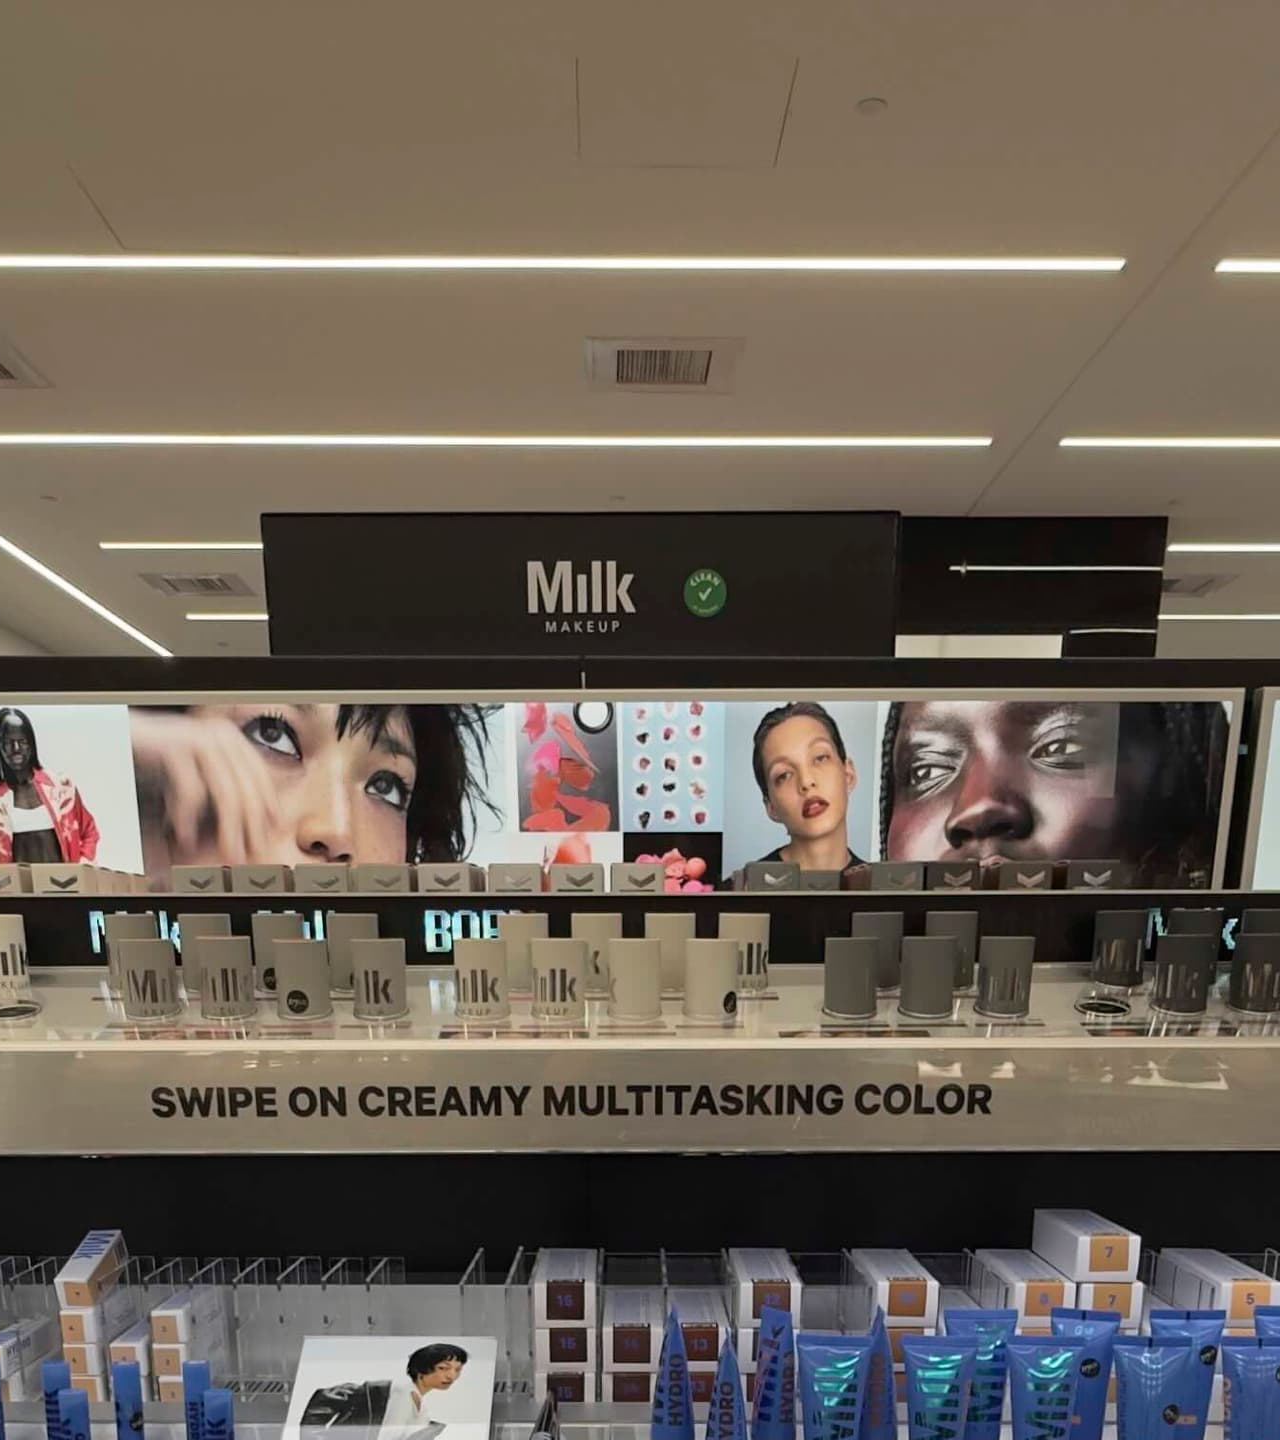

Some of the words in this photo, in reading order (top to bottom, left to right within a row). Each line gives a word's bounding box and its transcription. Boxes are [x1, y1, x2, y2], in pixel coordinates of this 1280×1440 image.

[526, 560, 636, 614] Milk
[688, 572, 722, 588] CLEAN
[545, 620, 621, 634] MAKEUP
[151, 1086, 278, 1118] SWIPE
[288, 1086, 347, 1118] ON
[358, 1085, 532, 1118] CREAMY
[543, 1083, 844, 1117] MULTITASKING
[854, 1083, 993, 1116] COLOR
[1245, 1292, 1256, 1305] 5
[668, 1352, 684, 1426] HYDRO
[778, 1350, 795, 1424] HYDRO
